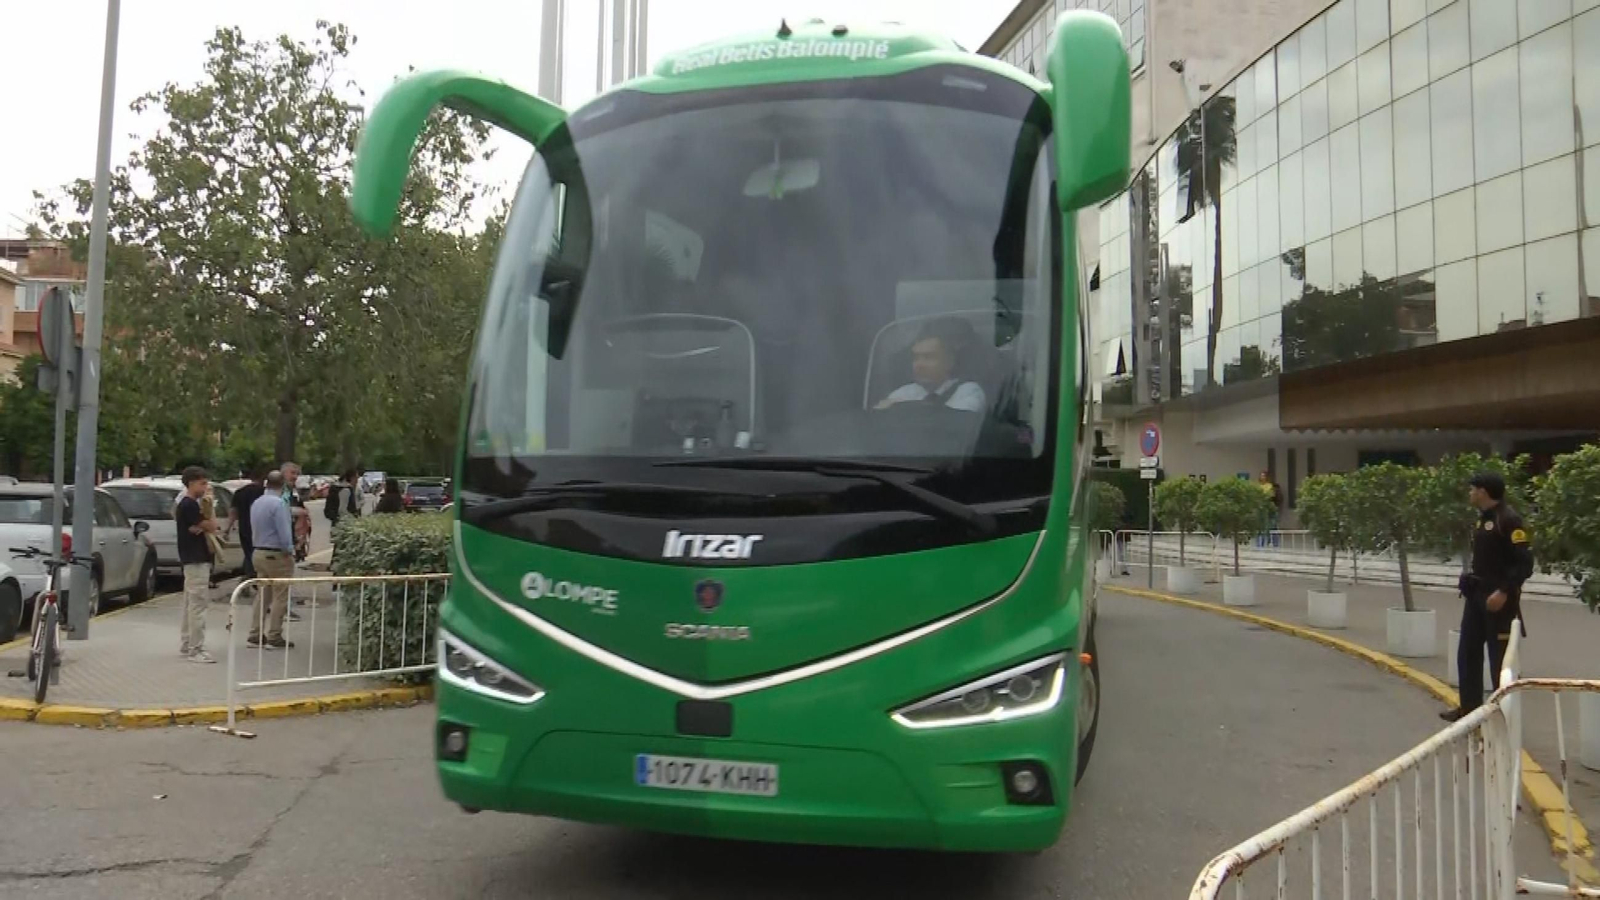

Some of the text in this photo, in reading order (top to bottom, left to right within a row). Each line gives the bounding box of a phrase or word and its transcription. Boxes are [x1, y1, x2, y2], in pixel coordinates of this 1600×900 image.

[671, 39, 889, 74] Real Betis Balompié
[661, 529, 763, 559] Irizar
[664, 622, 750, 641] SCANIA
